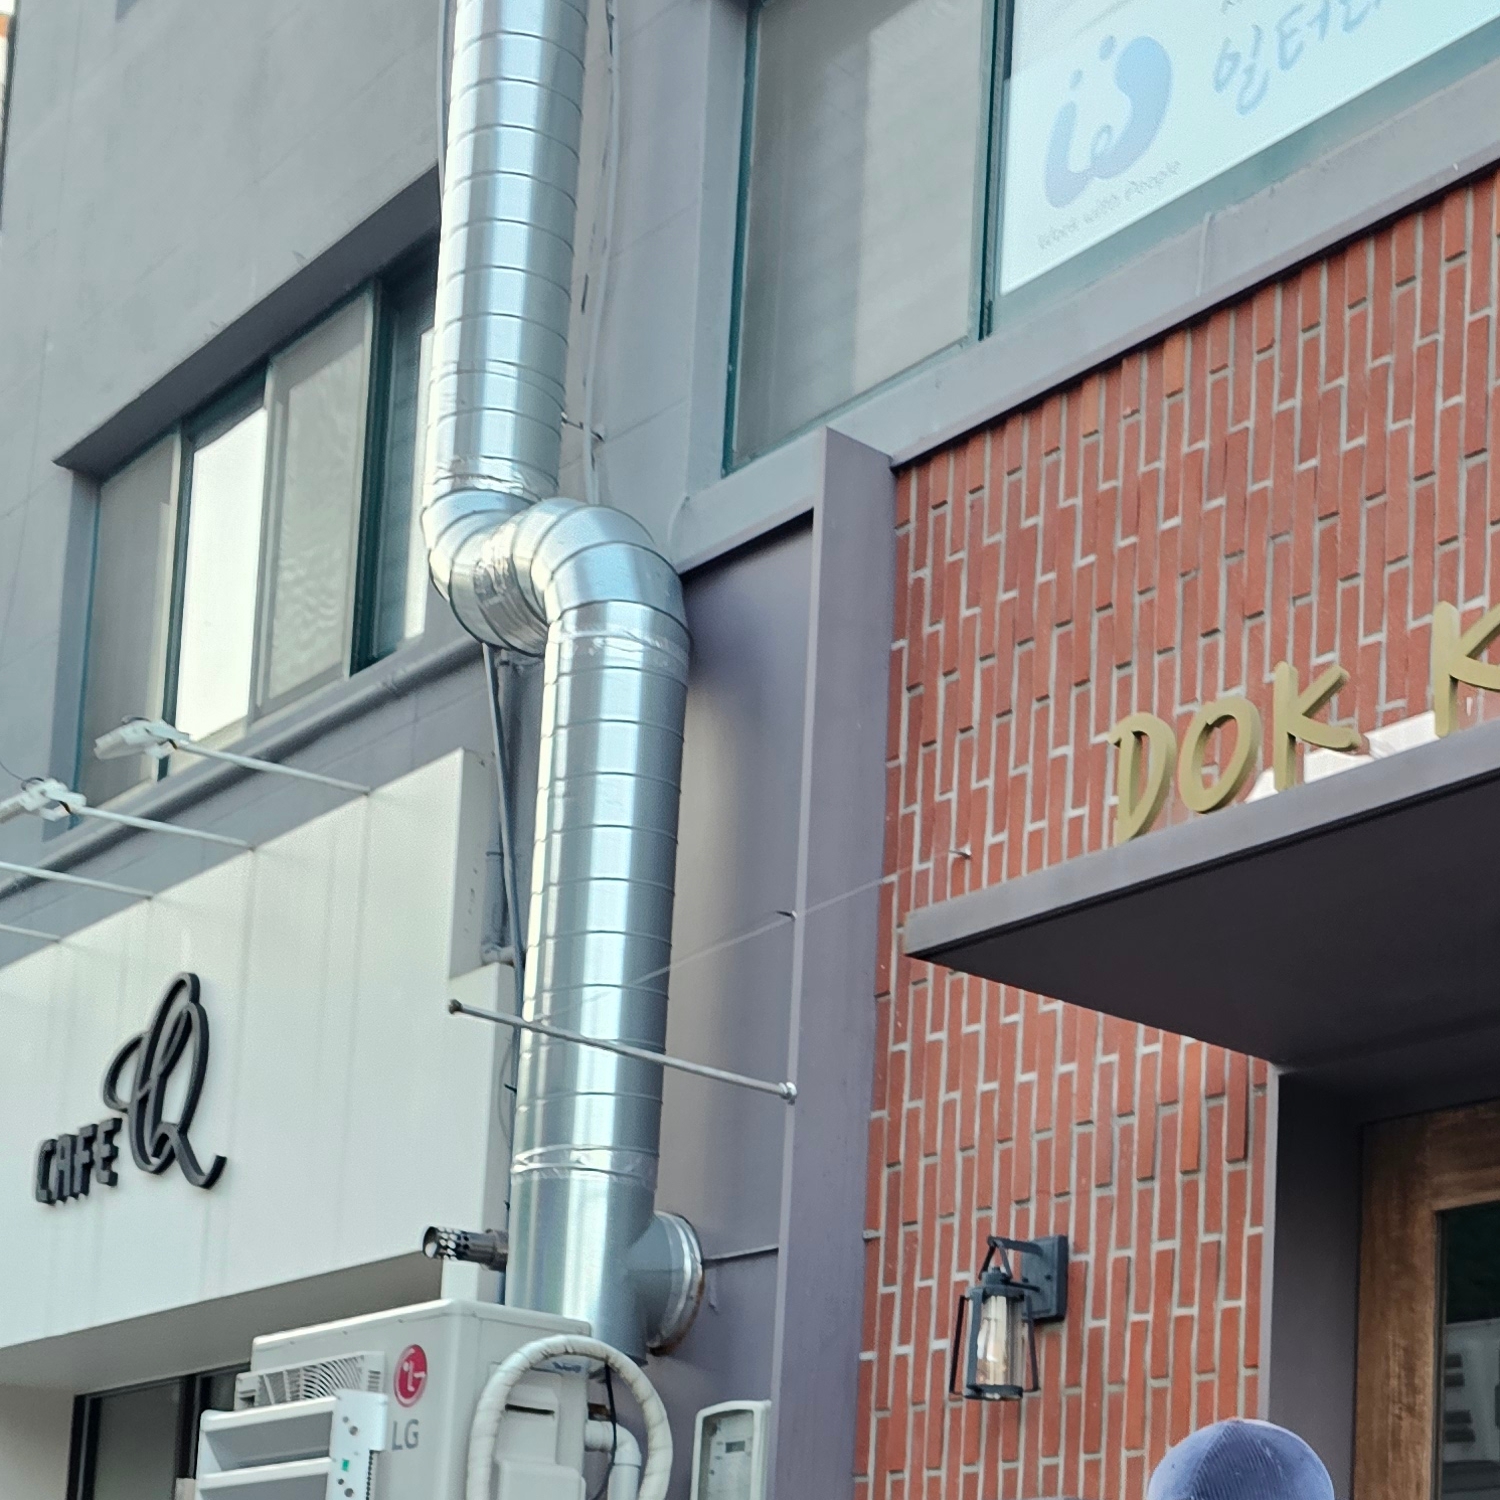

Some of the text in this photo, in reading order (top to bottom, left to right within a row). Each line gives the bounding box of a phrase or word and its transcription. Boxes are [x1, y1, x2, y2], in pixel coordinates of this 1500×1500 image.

[1108, 660, 1364, 847] DOK
[36, 1117, 123, 1206] CAFE
[391, 1419, 419, 1450] LG
